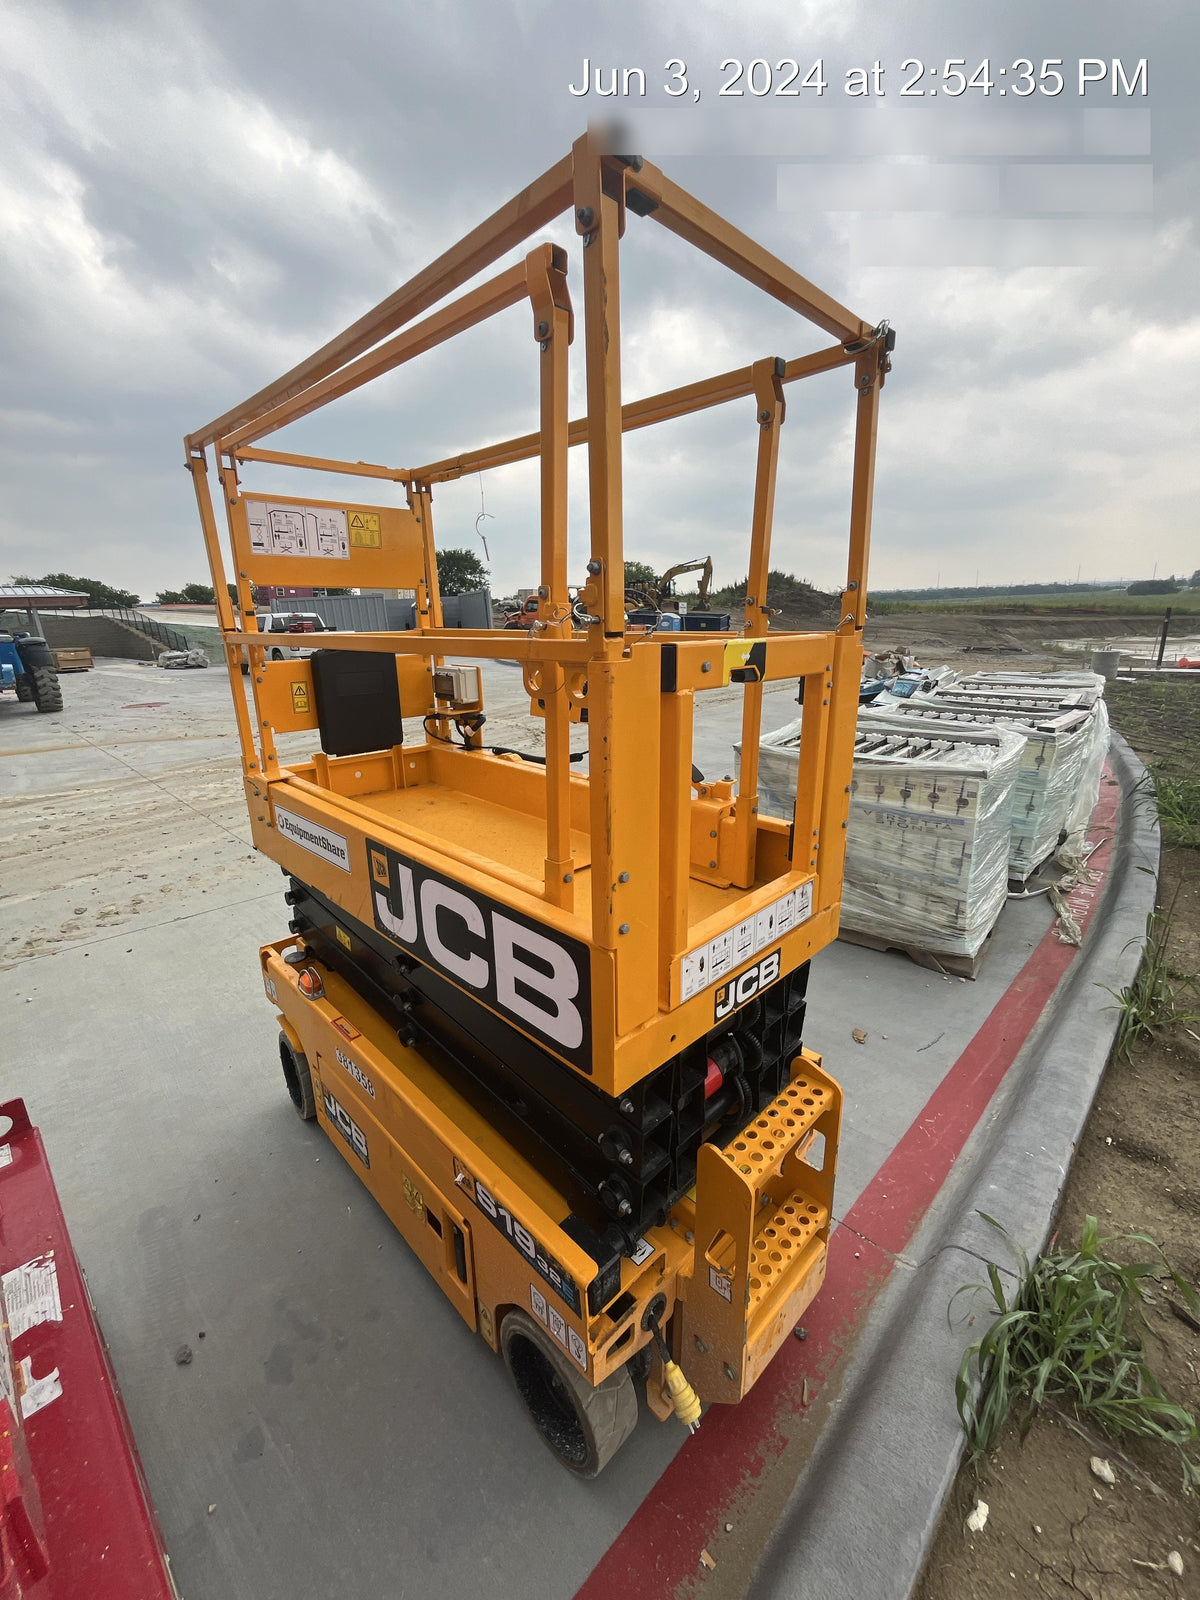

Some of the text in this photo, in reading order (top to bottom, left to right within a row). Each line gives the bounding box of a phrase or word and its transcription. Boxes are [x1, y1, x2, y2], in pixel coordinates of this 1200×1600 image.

[284, 817, 346, 860] EquipmentShare
[375, 863, 583, 1049] JCB
[716, 953, 780, 1018] JCB
[324, 1094, 368, 1157] JCB
